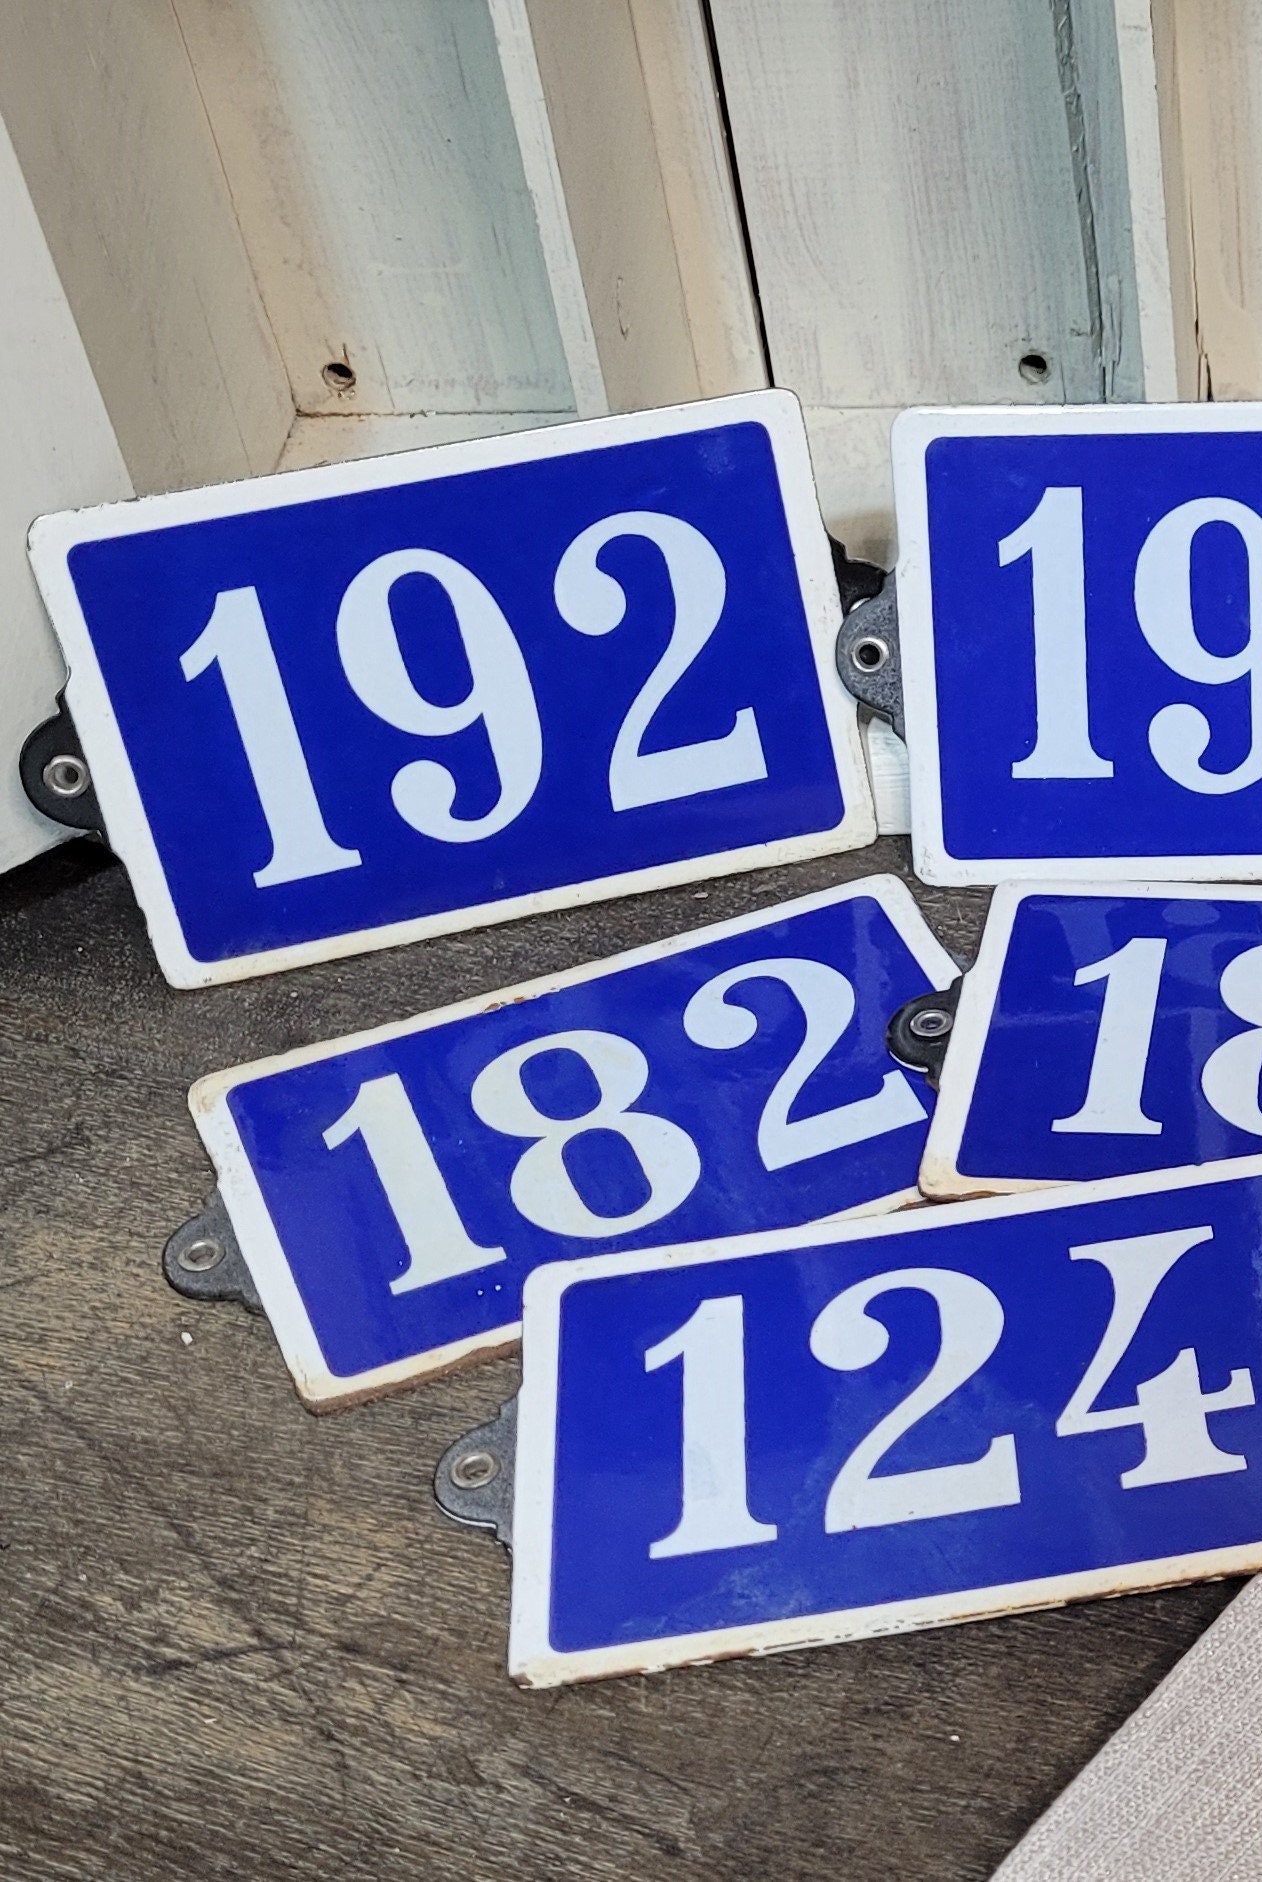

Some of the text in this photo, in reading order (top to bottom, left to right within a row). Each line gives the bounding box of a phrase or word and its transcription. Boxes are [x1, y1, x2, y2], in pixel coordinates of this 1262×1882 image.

[180, 511, 767, 888] 192
[322, 958, 928, 1295] 182
[645, 1226, 1255, 1560] 124
